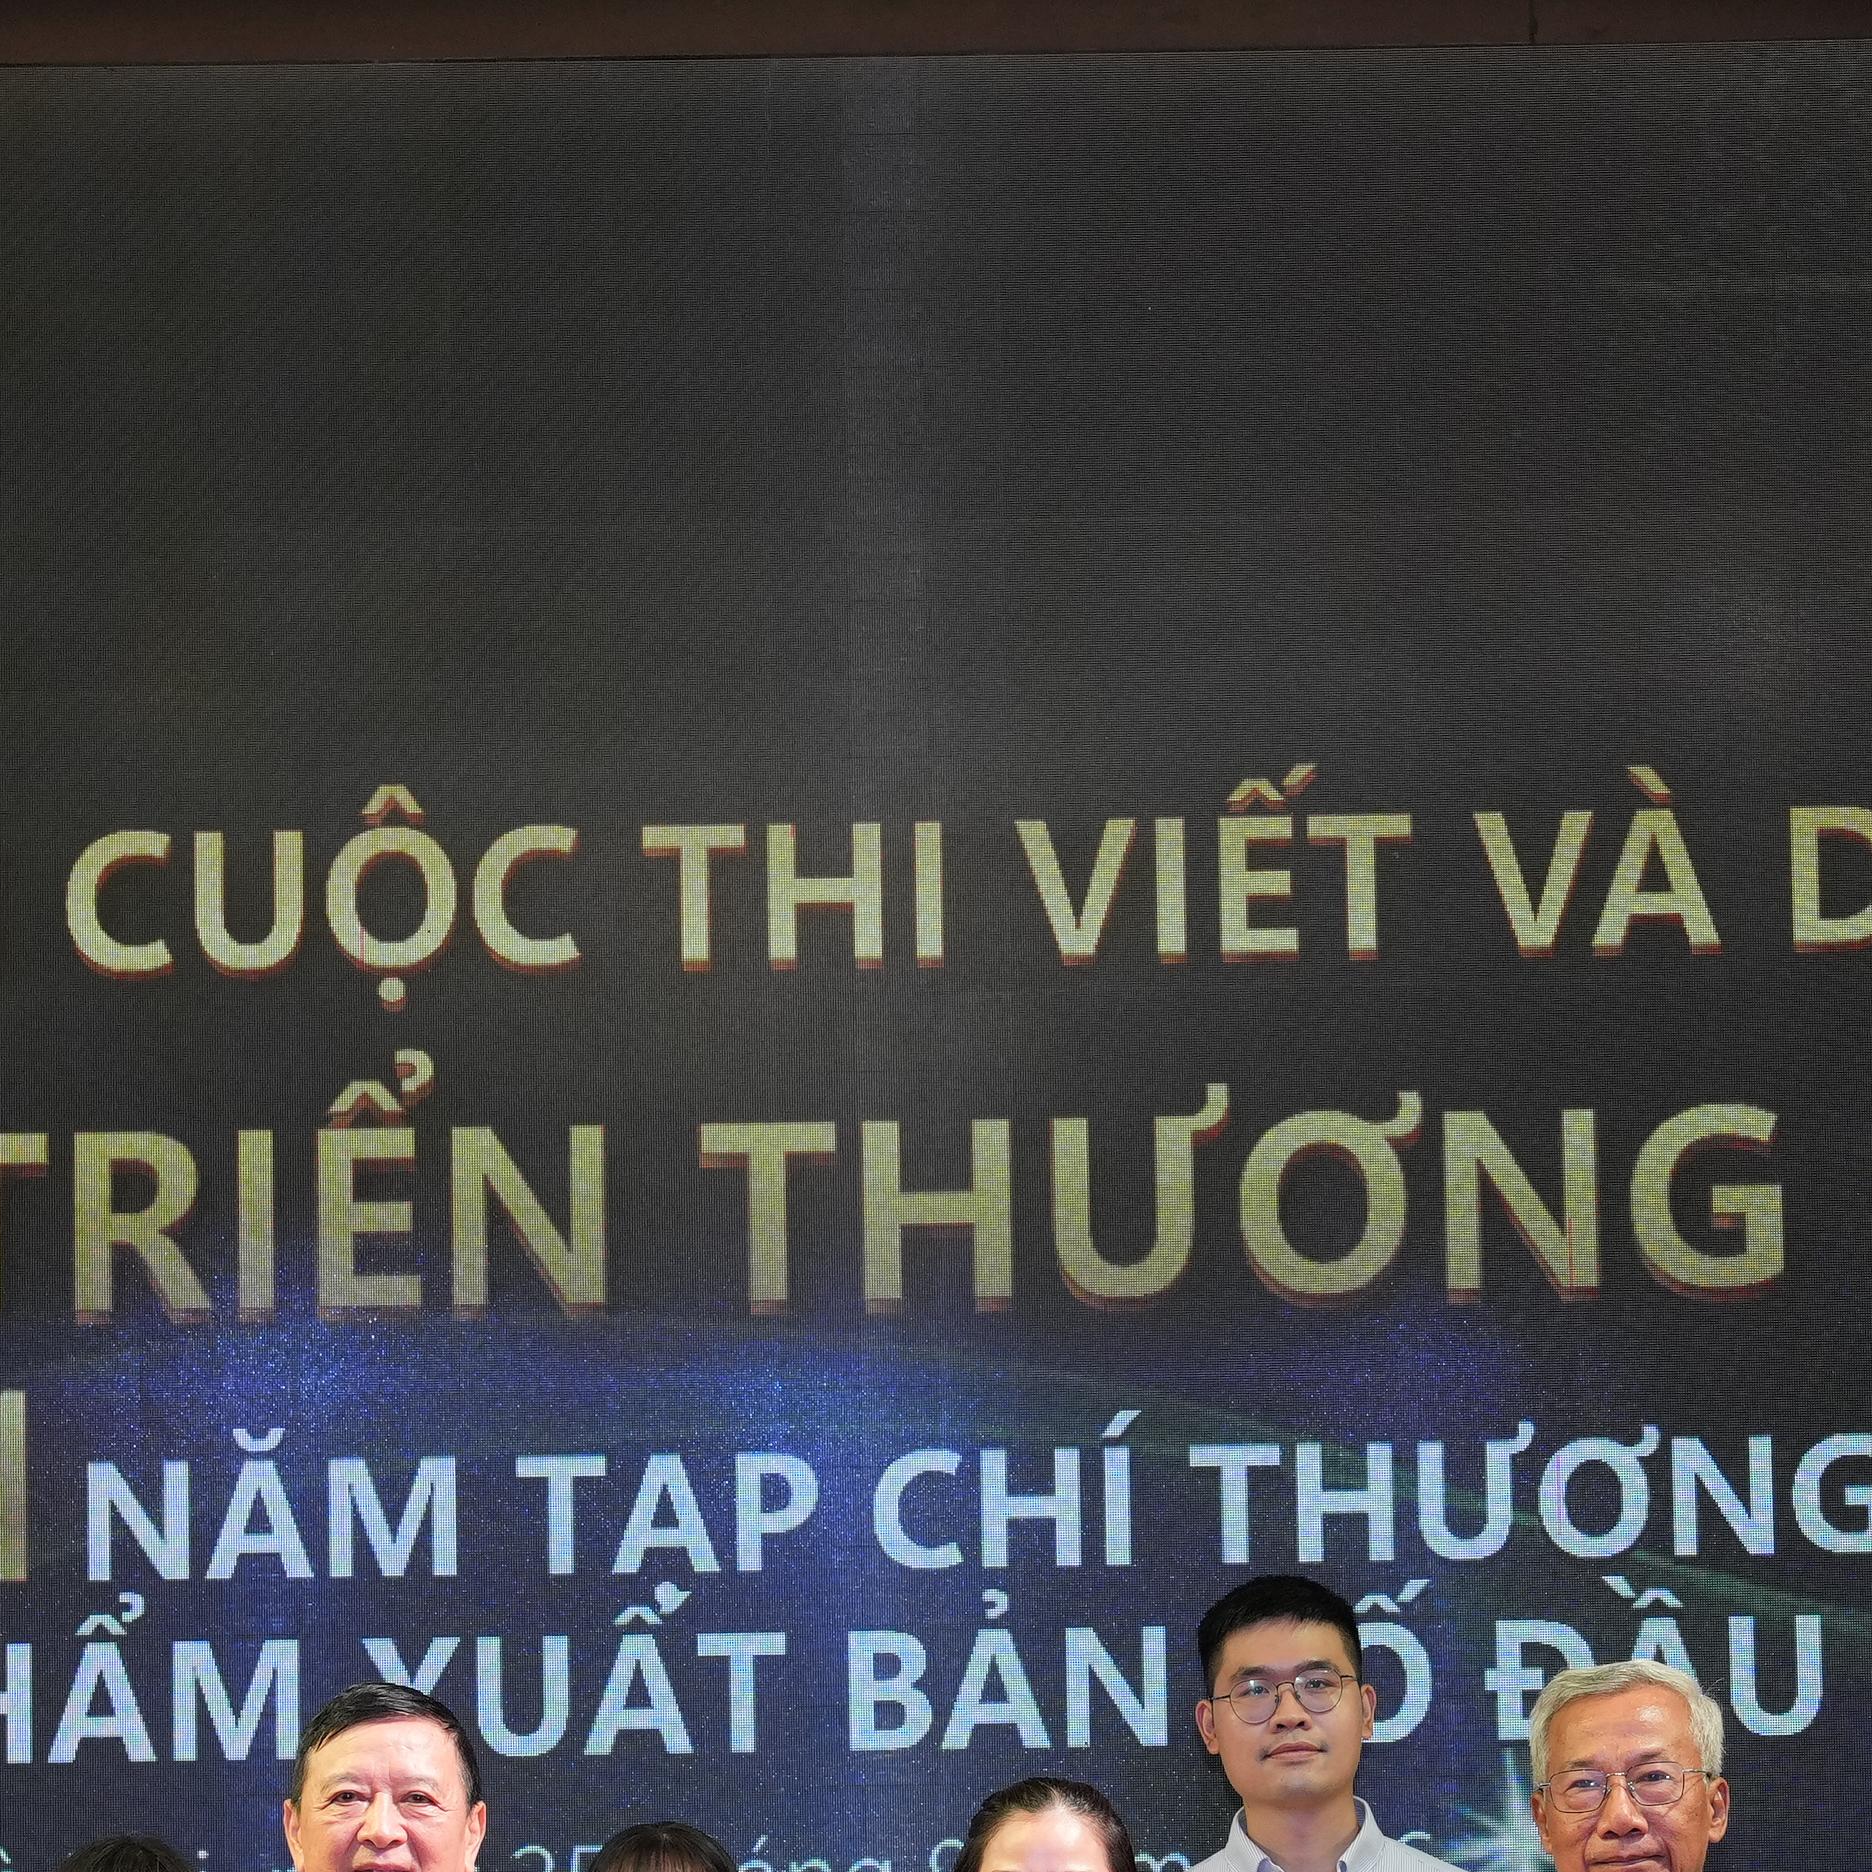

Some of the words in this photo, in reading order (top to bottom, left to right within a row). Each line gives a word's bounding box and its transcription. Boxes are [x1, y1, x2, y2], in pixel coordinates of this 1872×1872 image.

[65, 784, 581, 1009] CUỘC
[640, 819, 946, 972] THI
[1014, 763, 1412, 965] VIẾT
[1474, 766, 1720, 953] VÀ
[698, 1082, 1783, 1313] THƯƠNG
[84, 1427, 461, 1580] NĂM
[515, 1452, 821, 1613] TẠP
[871, 1409, 1141, 1573] CHÍ
[846, 1585, 1171, 1754] BẢN
[1354, 1577, 1434, 1744] Ố
